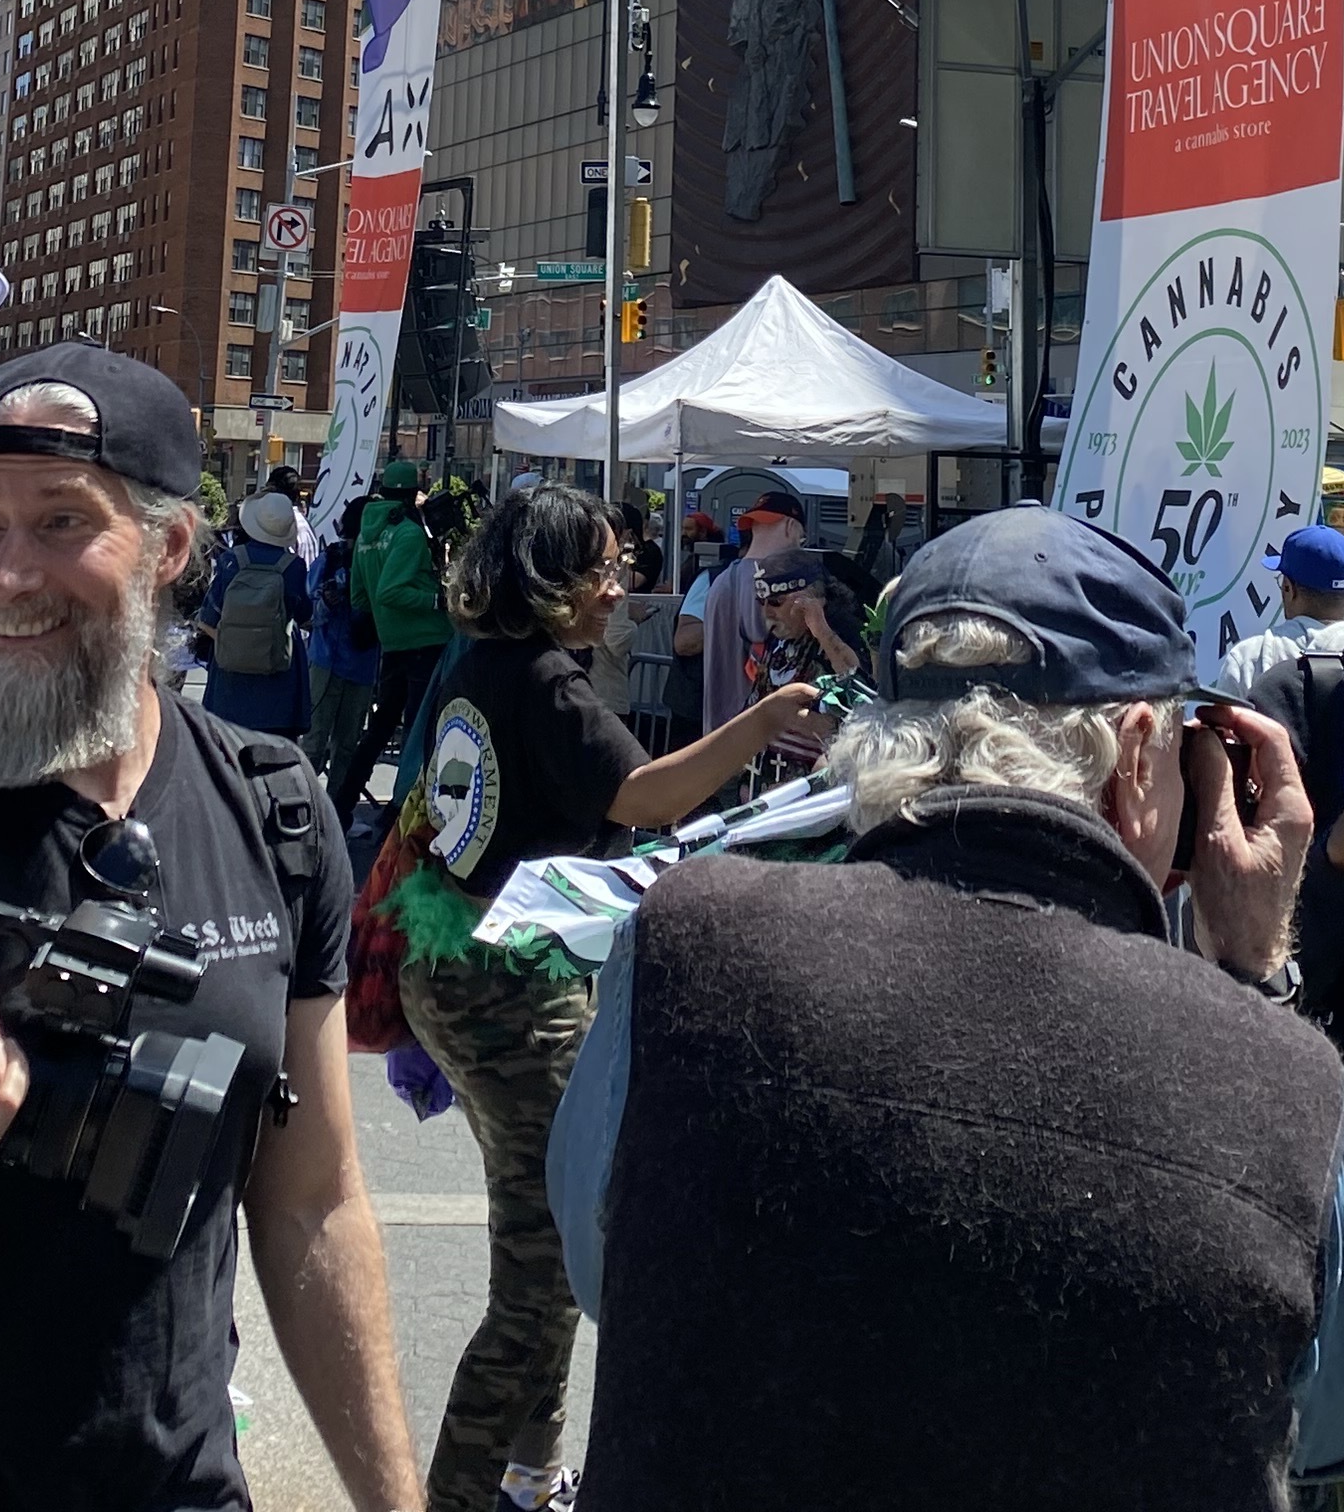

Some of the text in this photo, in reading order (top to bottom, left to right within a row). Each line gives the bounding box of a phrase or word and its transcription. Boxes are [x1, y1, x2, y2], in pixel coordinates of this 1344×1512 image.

[1130, 14, 1210, 83] UNION
[1126, 40, 1328, 134] TRAVEL AGENCY
[1174, 117, 1273, 153] a cannabis store
[587, 168, 608, 177] ONE
[540, 263, 604, 274] UNION SQUARE
[1113, 255, 1302, 401] CANNABIS
[1088, 431, 1118, 457] 1973
[1281, 428, 1311, 455] 2023
[228, 911, 280, 943] Wreck
